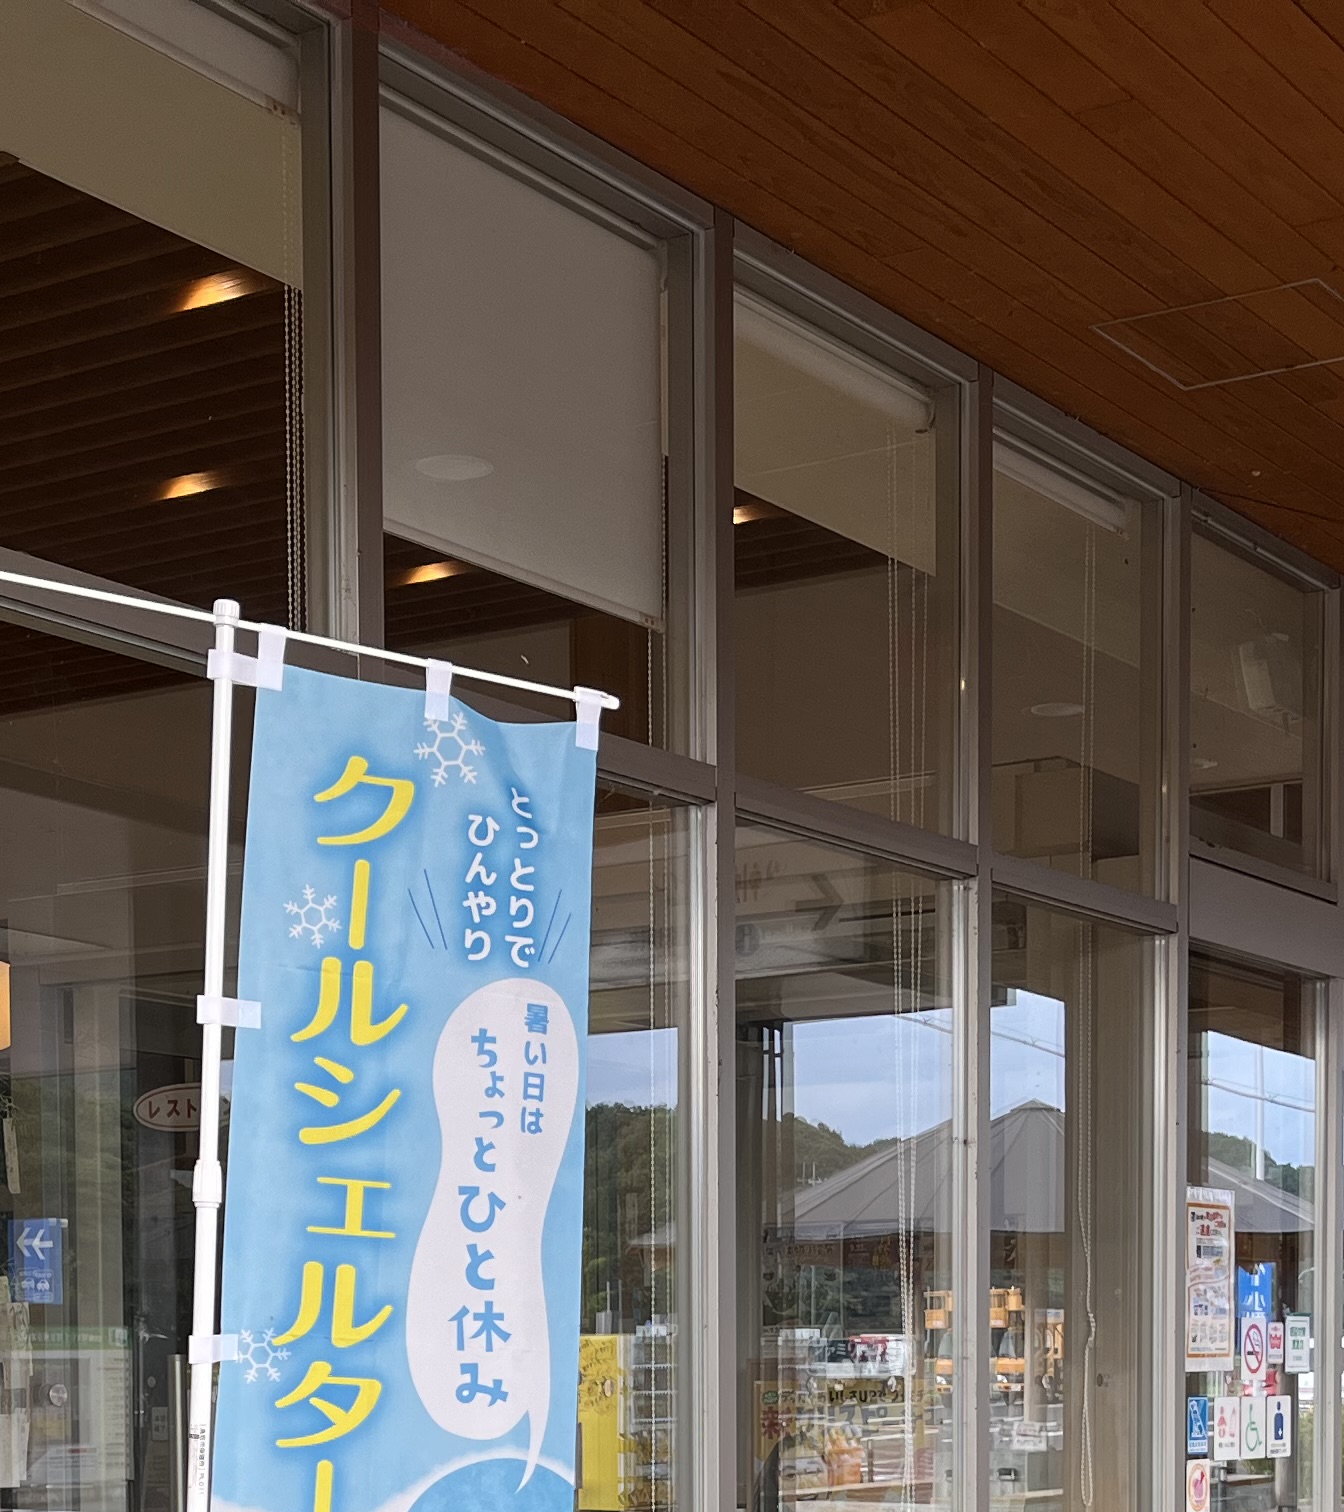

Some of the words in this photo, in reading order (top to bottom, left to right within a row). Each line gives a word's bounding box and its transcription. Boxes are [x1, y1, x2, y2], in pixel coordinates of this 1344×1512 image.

[462, 813, 501, 961] ひんやり
[505, 787, 540, 969] とっとりで
[520, 1003, 550, 1136] 暑い日は
[447, 1028, 513, 1409] ちょっとひと休み
